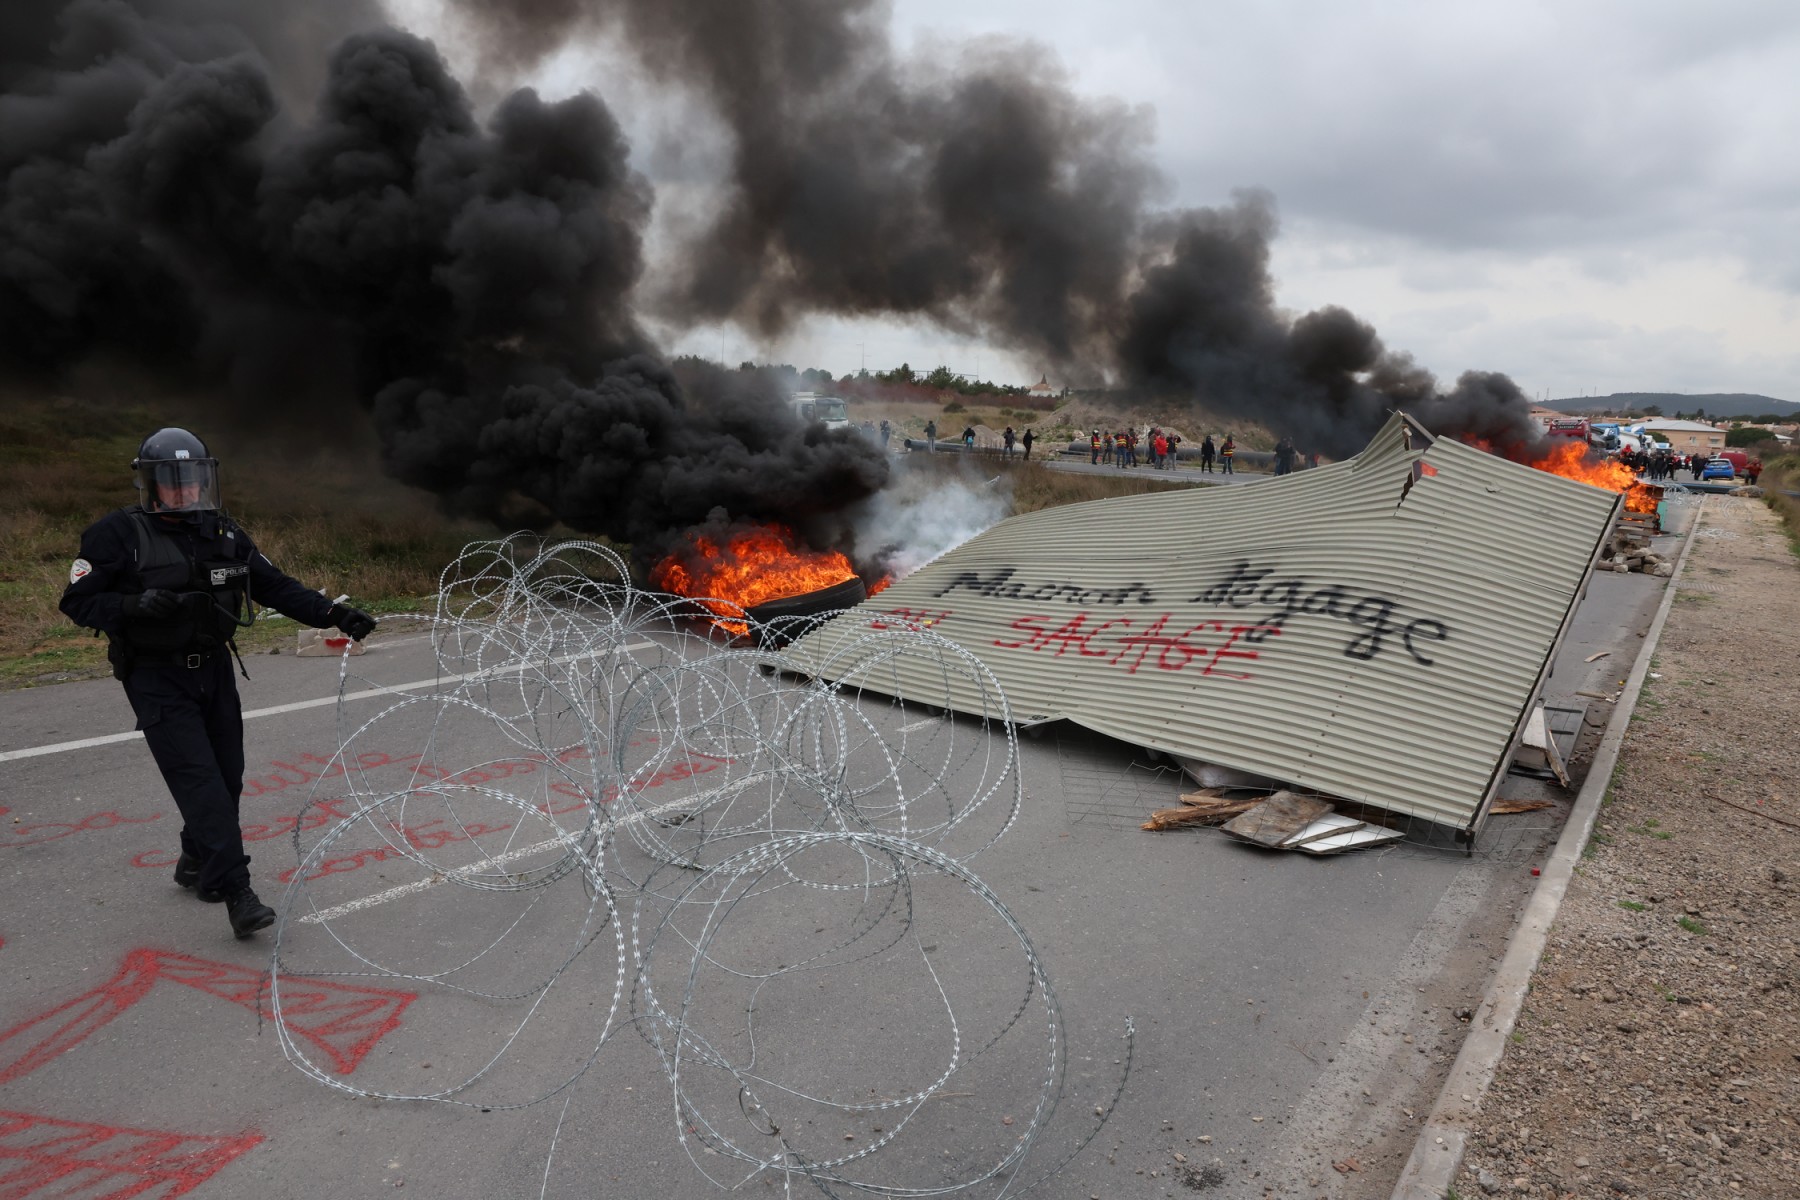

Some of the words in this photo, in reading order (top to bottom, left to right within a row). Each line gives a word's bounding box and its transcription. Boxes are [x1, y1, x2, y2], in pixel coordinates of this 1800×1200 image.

[225, 565, 248, 577] POLICE
[932, 566, 1157, 605] Macron
[1188, 558, 1449, 666] dégage
[993, 610, 1282, 680] SACAGE
[242, 752, 424, 798] utte
